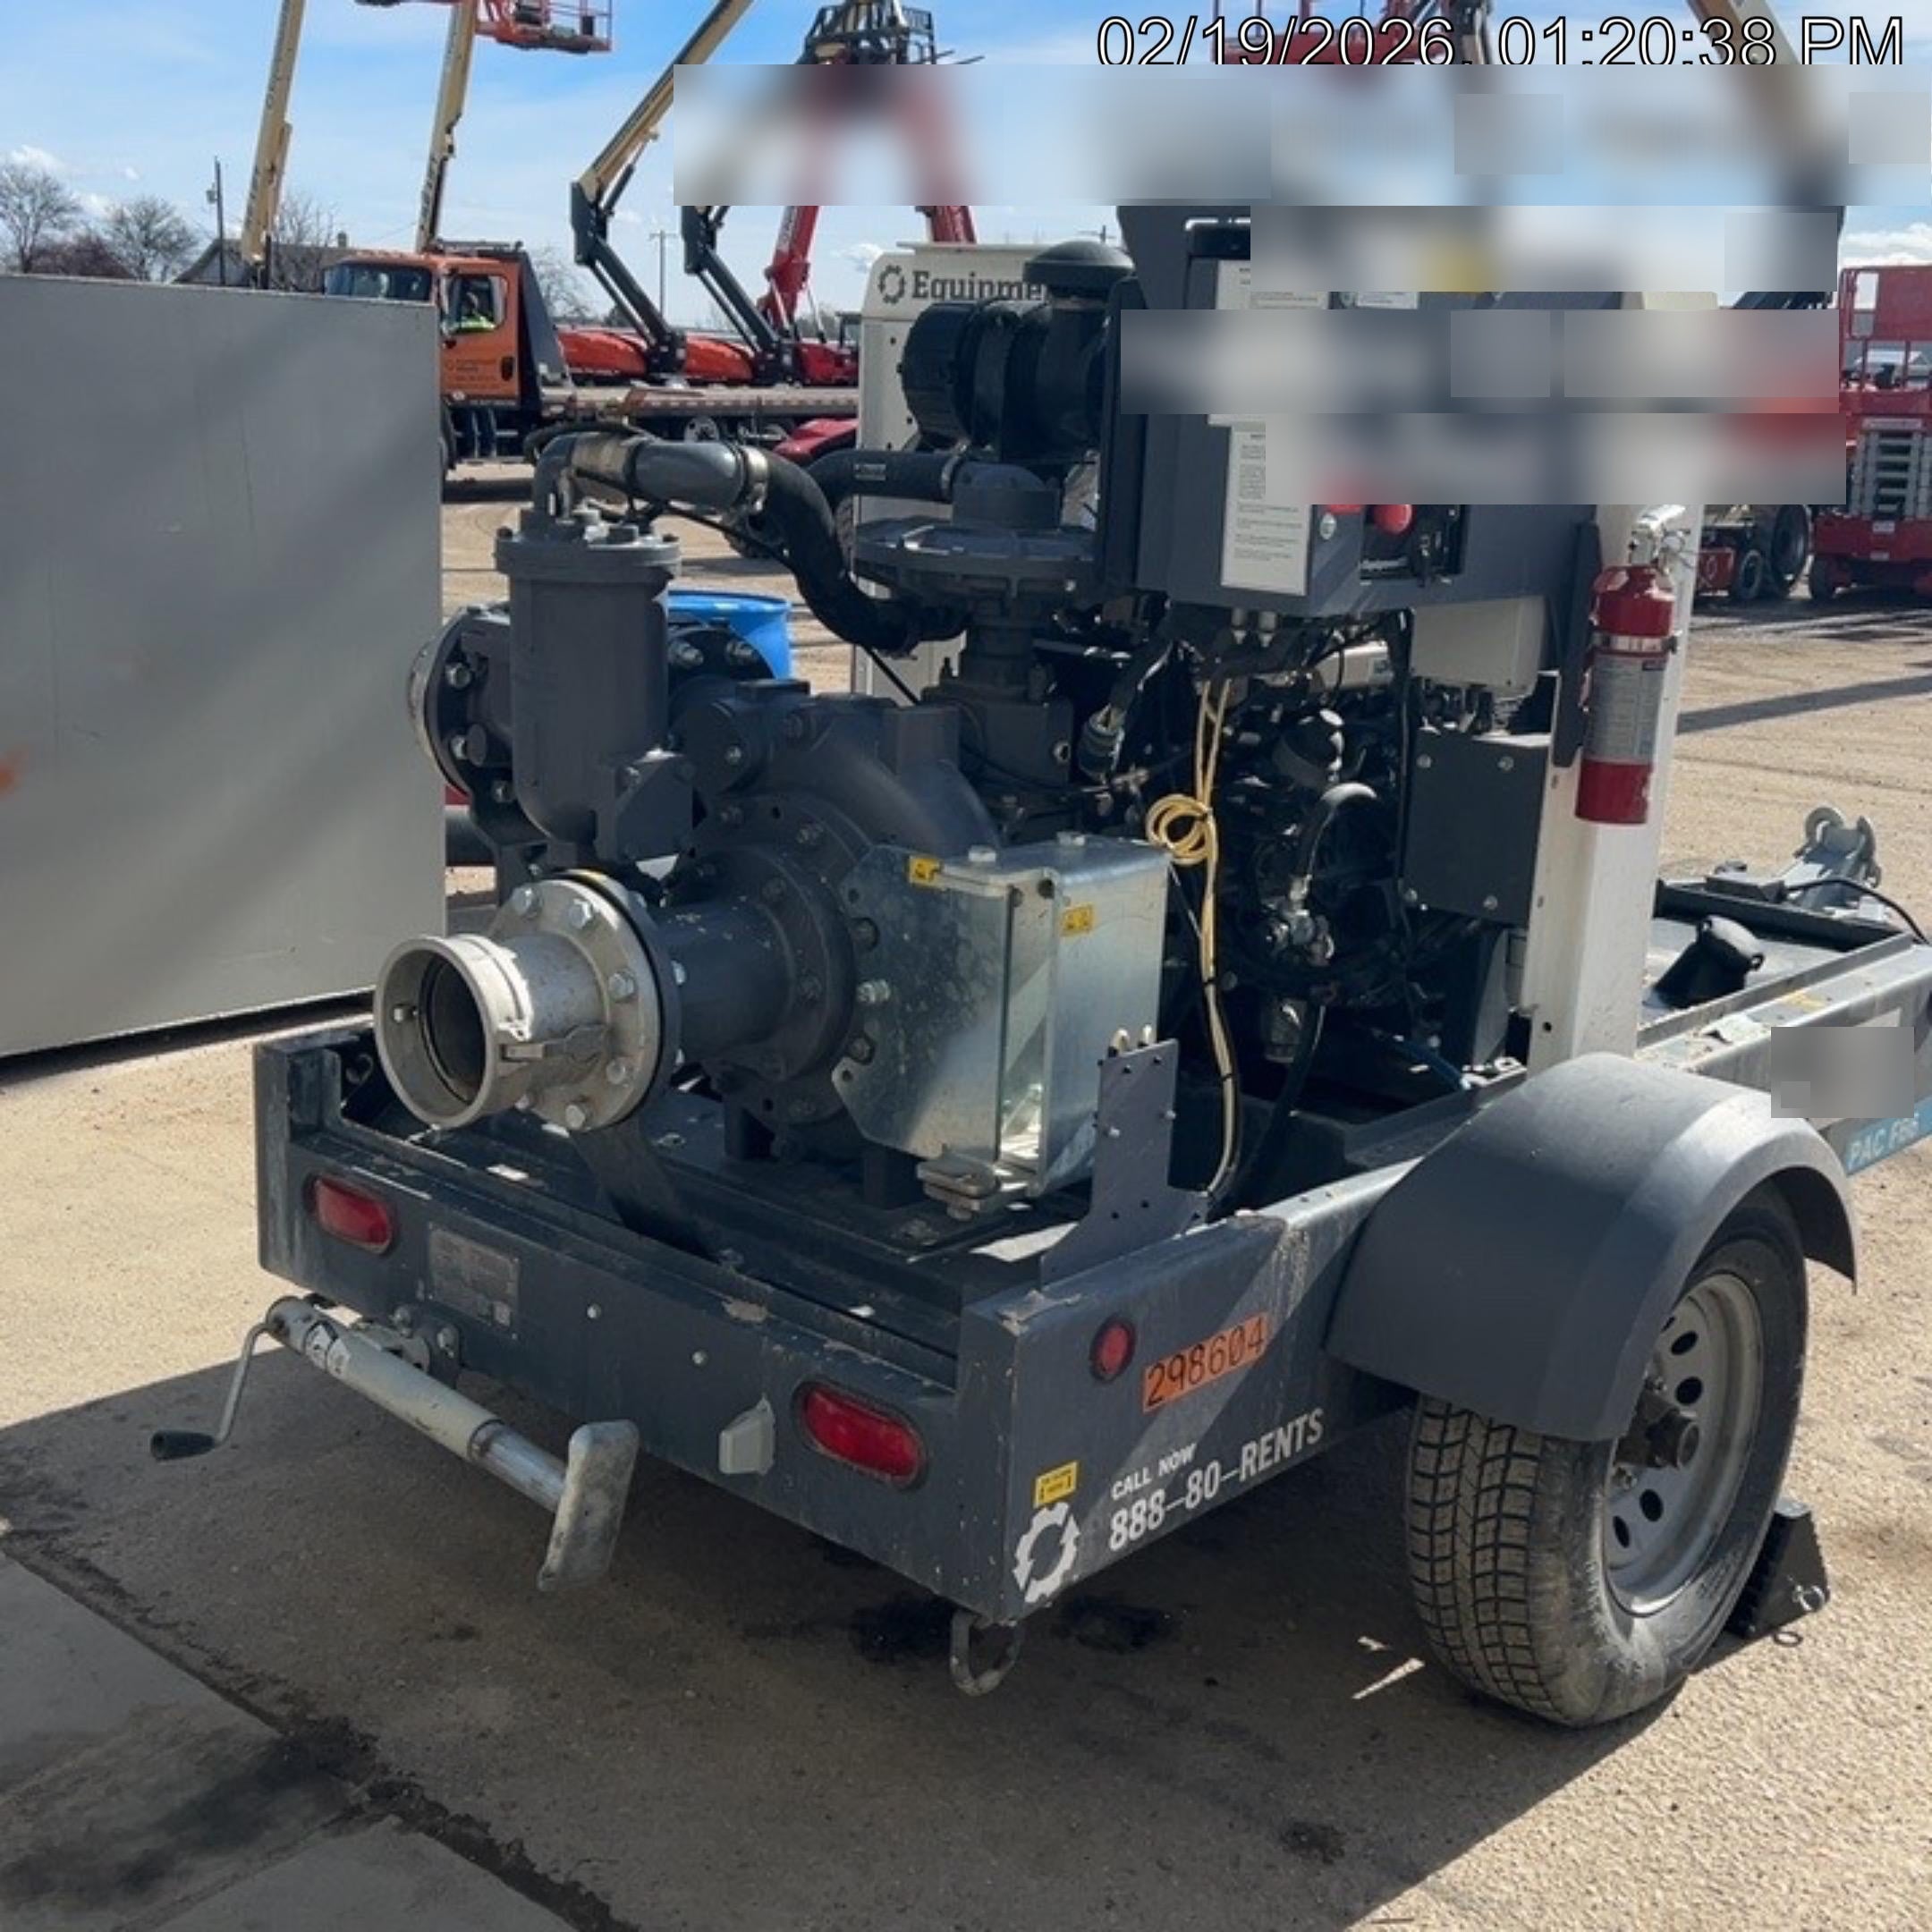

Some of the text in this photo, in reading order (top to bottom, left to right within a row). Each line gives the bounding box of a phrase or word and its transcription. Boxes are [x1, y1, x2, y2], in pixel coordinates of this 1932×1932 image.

[911, 270, 1045, 301] Equipme
[1148, 1318, 1266, 1407] 298604
[1111, 1467, 1152, 1501] CALL
[1157, 1443, 1198, 1477] NOW
